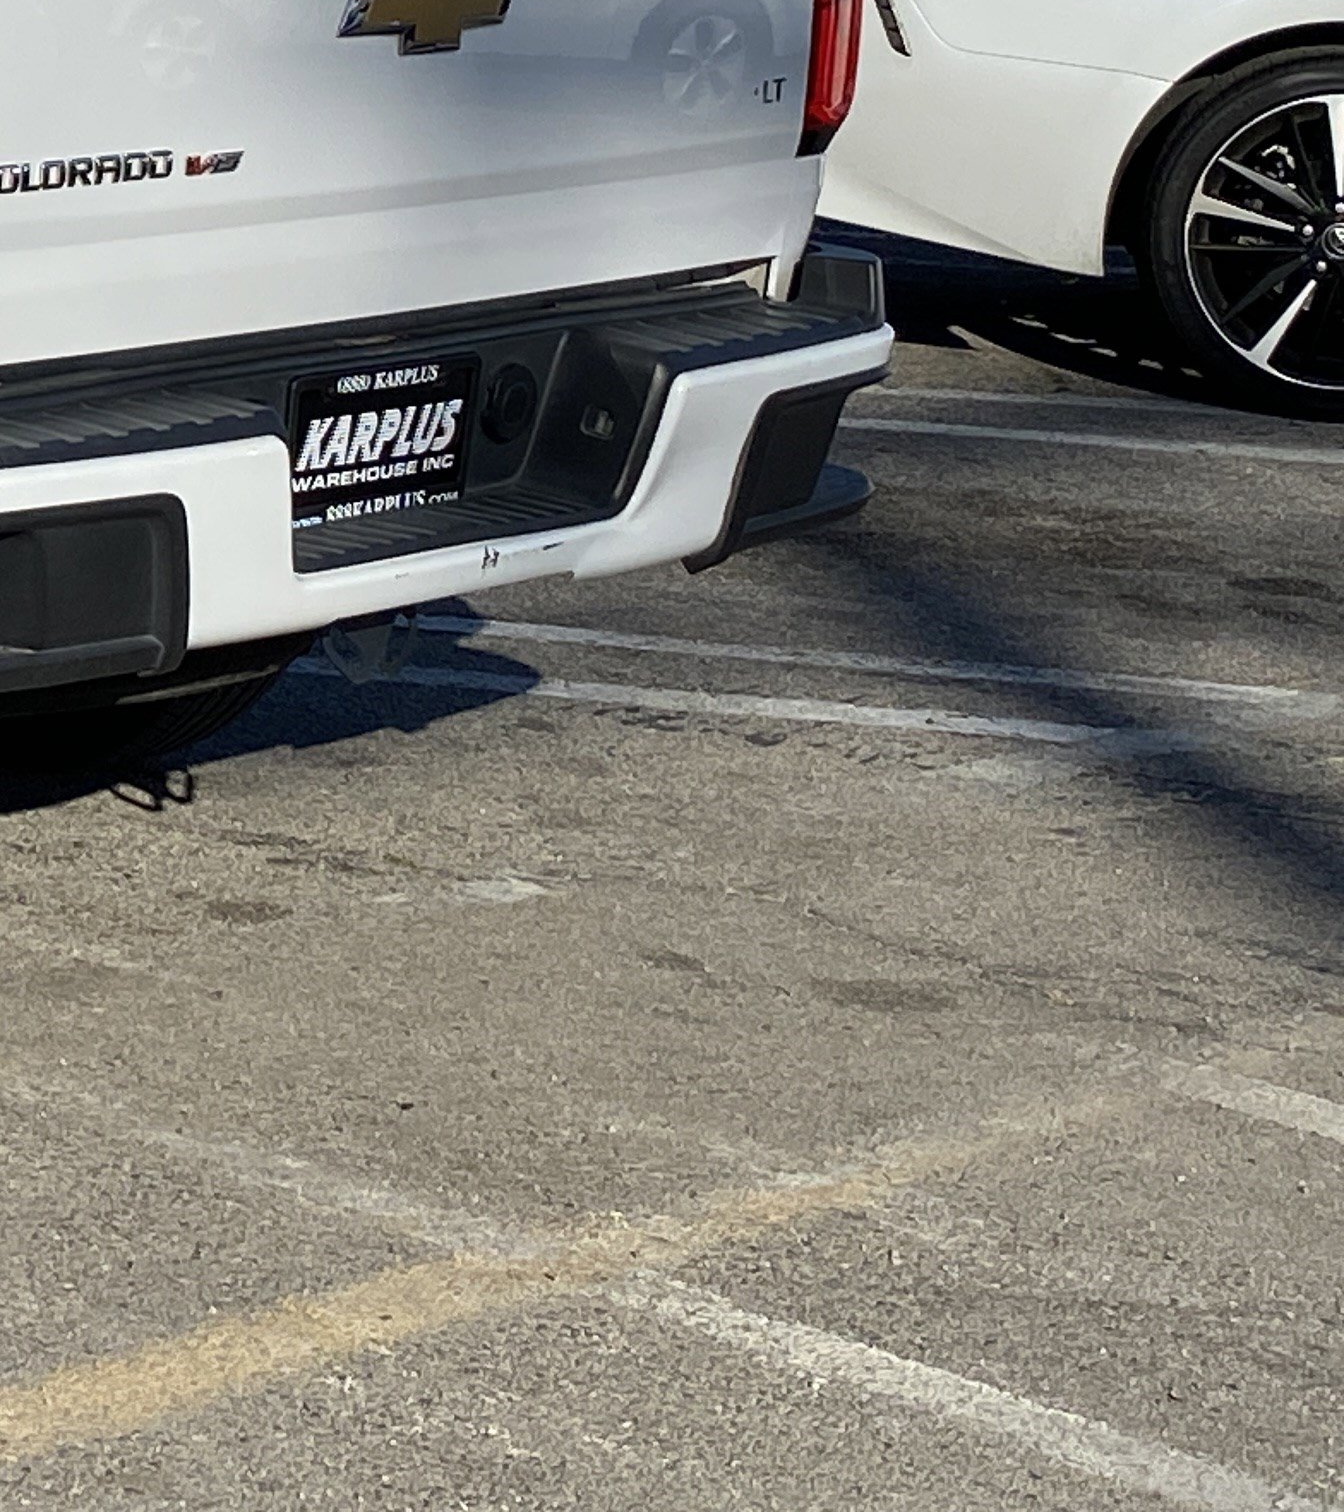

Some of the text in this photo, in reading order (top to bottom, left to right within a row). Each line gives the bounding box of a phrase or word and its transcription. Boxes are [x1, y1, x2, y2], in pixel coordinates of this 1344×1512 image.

[373, 364, 441, 390] KARPLUS
[294, 398, 463, 473] KARPLUS
[291, 454, 455, 493] WAREHOUSE INC
